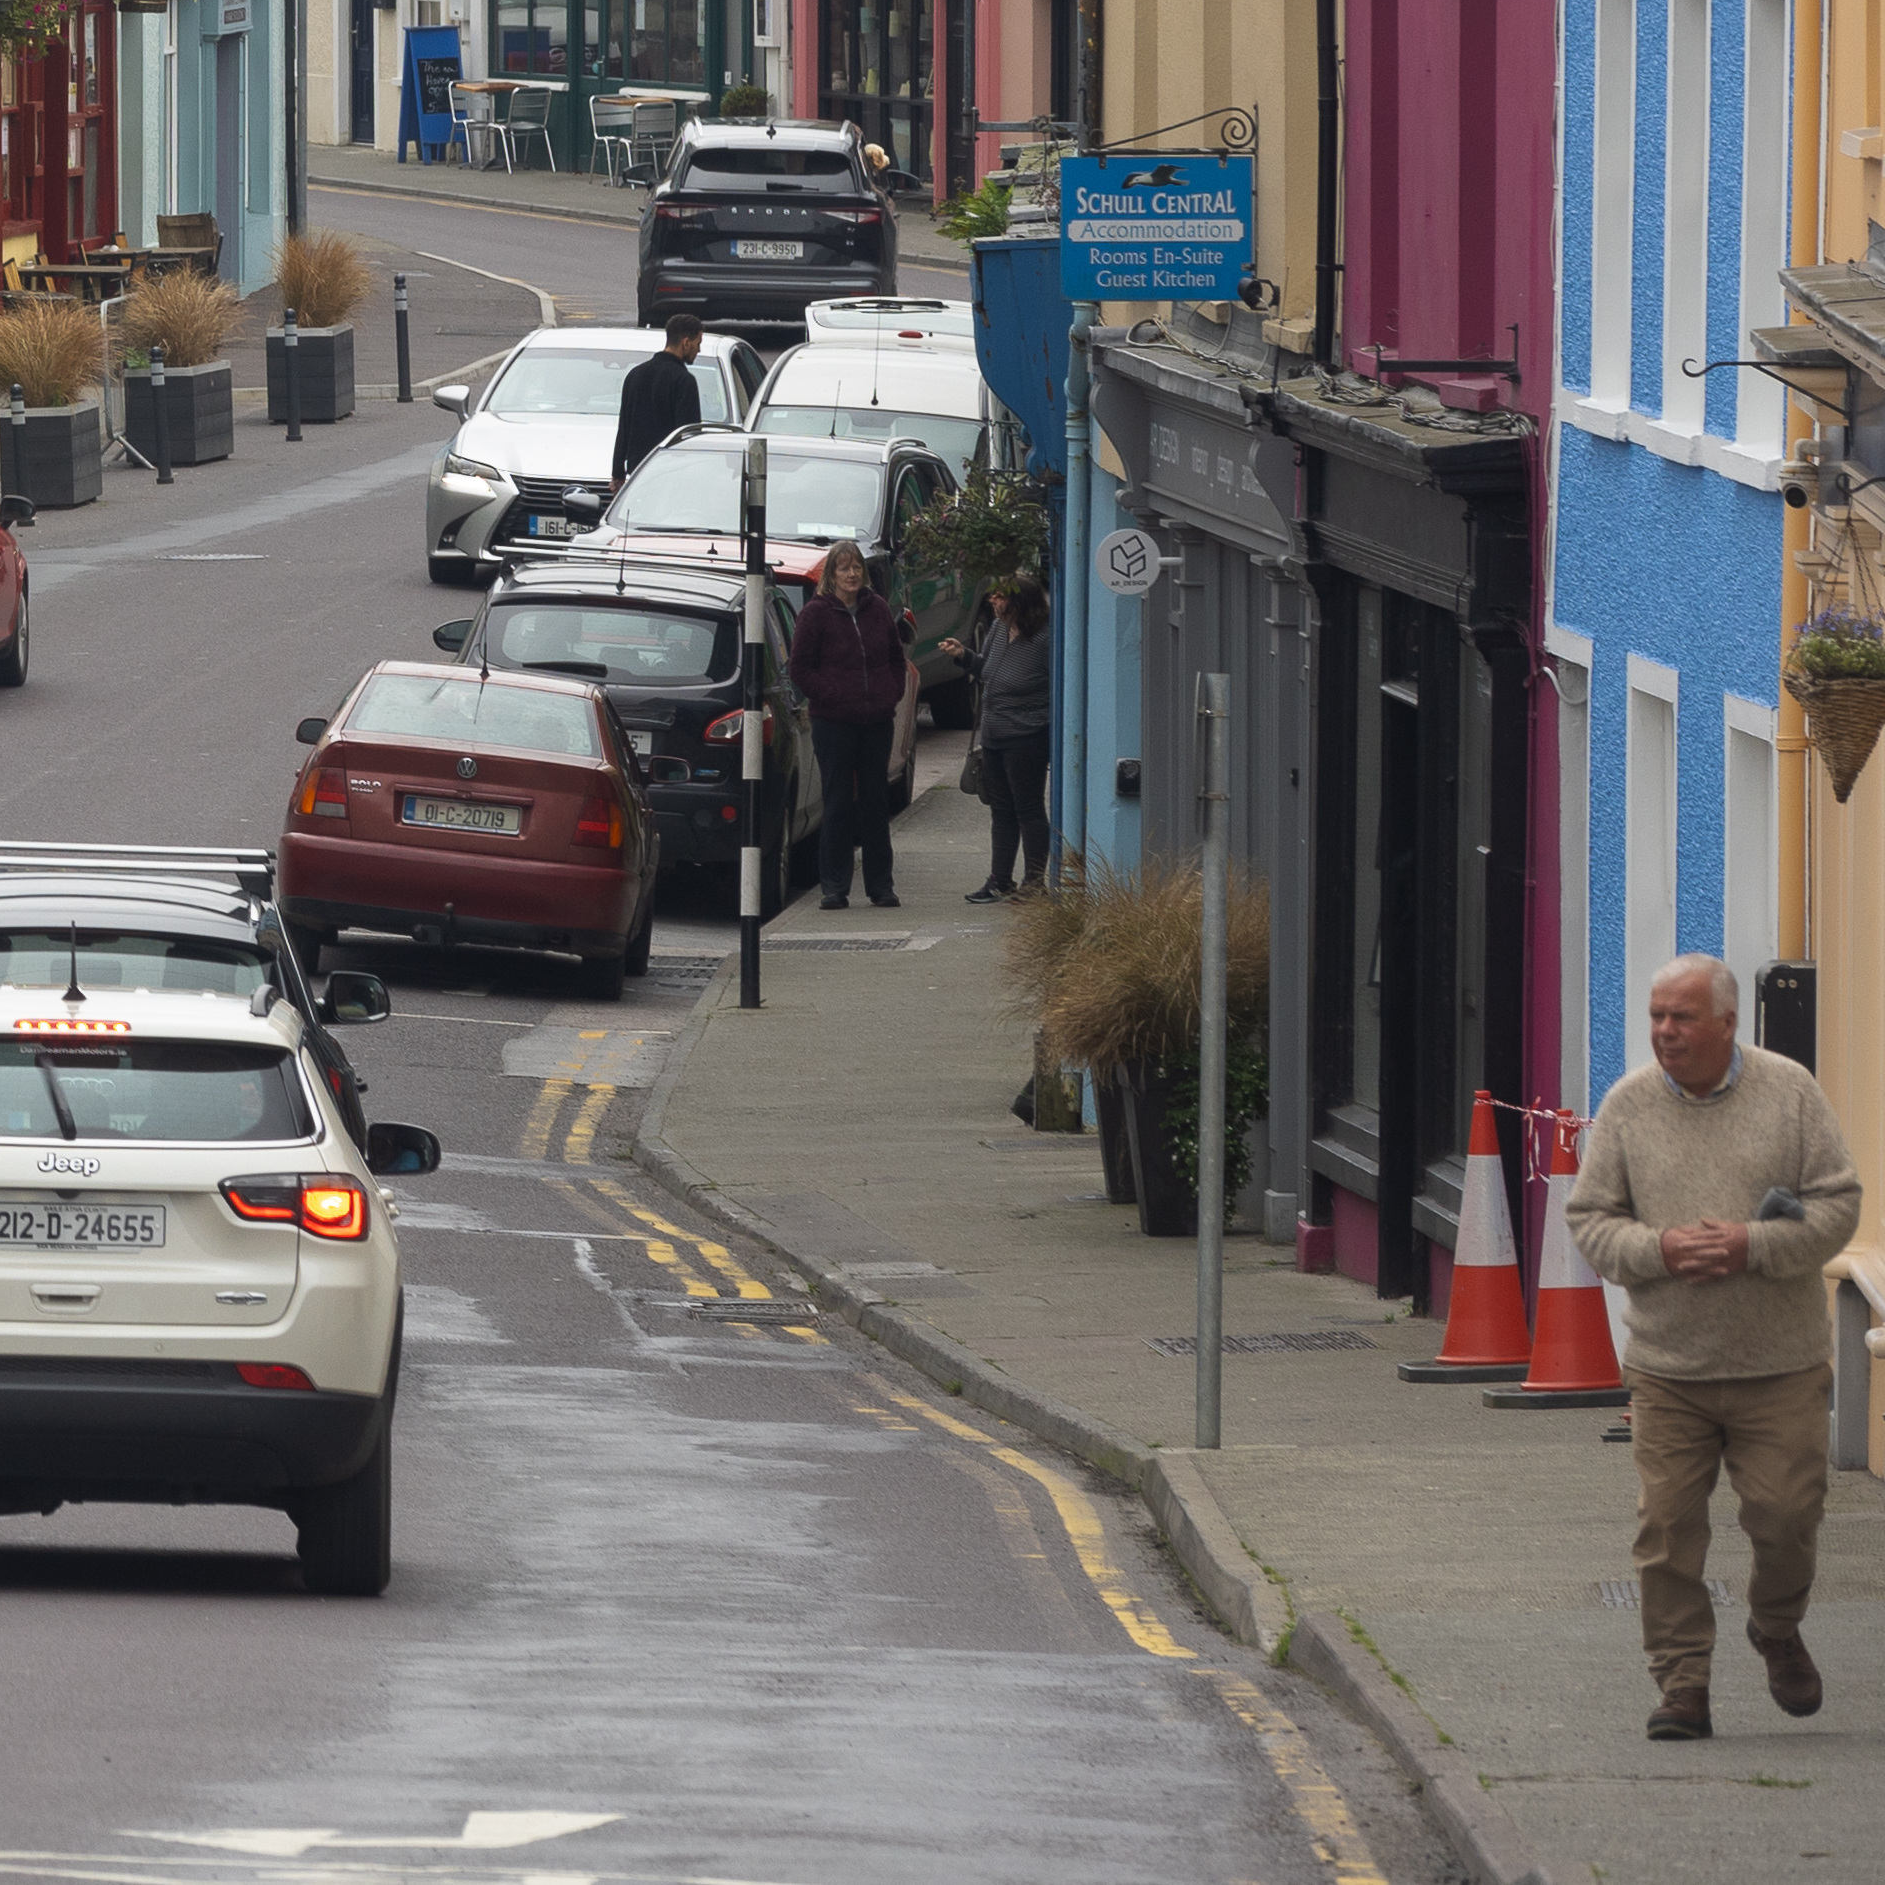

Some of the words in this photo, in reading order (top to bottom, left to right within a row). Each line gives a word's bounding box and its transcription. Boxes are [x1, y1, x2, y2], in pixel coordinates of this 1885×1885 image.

[1080, 221, 1233, 238] Accommodation
[743, 242, 797, 256] 231-C-9950
[1090, 247, 1147, 264] Rooms
[1154, 247, 1224, 264] En-Suite
[1096, 270, 1147, 287] Guest
[1153, 270, 1216, 287] Kitchen
[425, 804, 505, 827] 01-C-20719
[37, 1153, 100, 1176] Jeep
